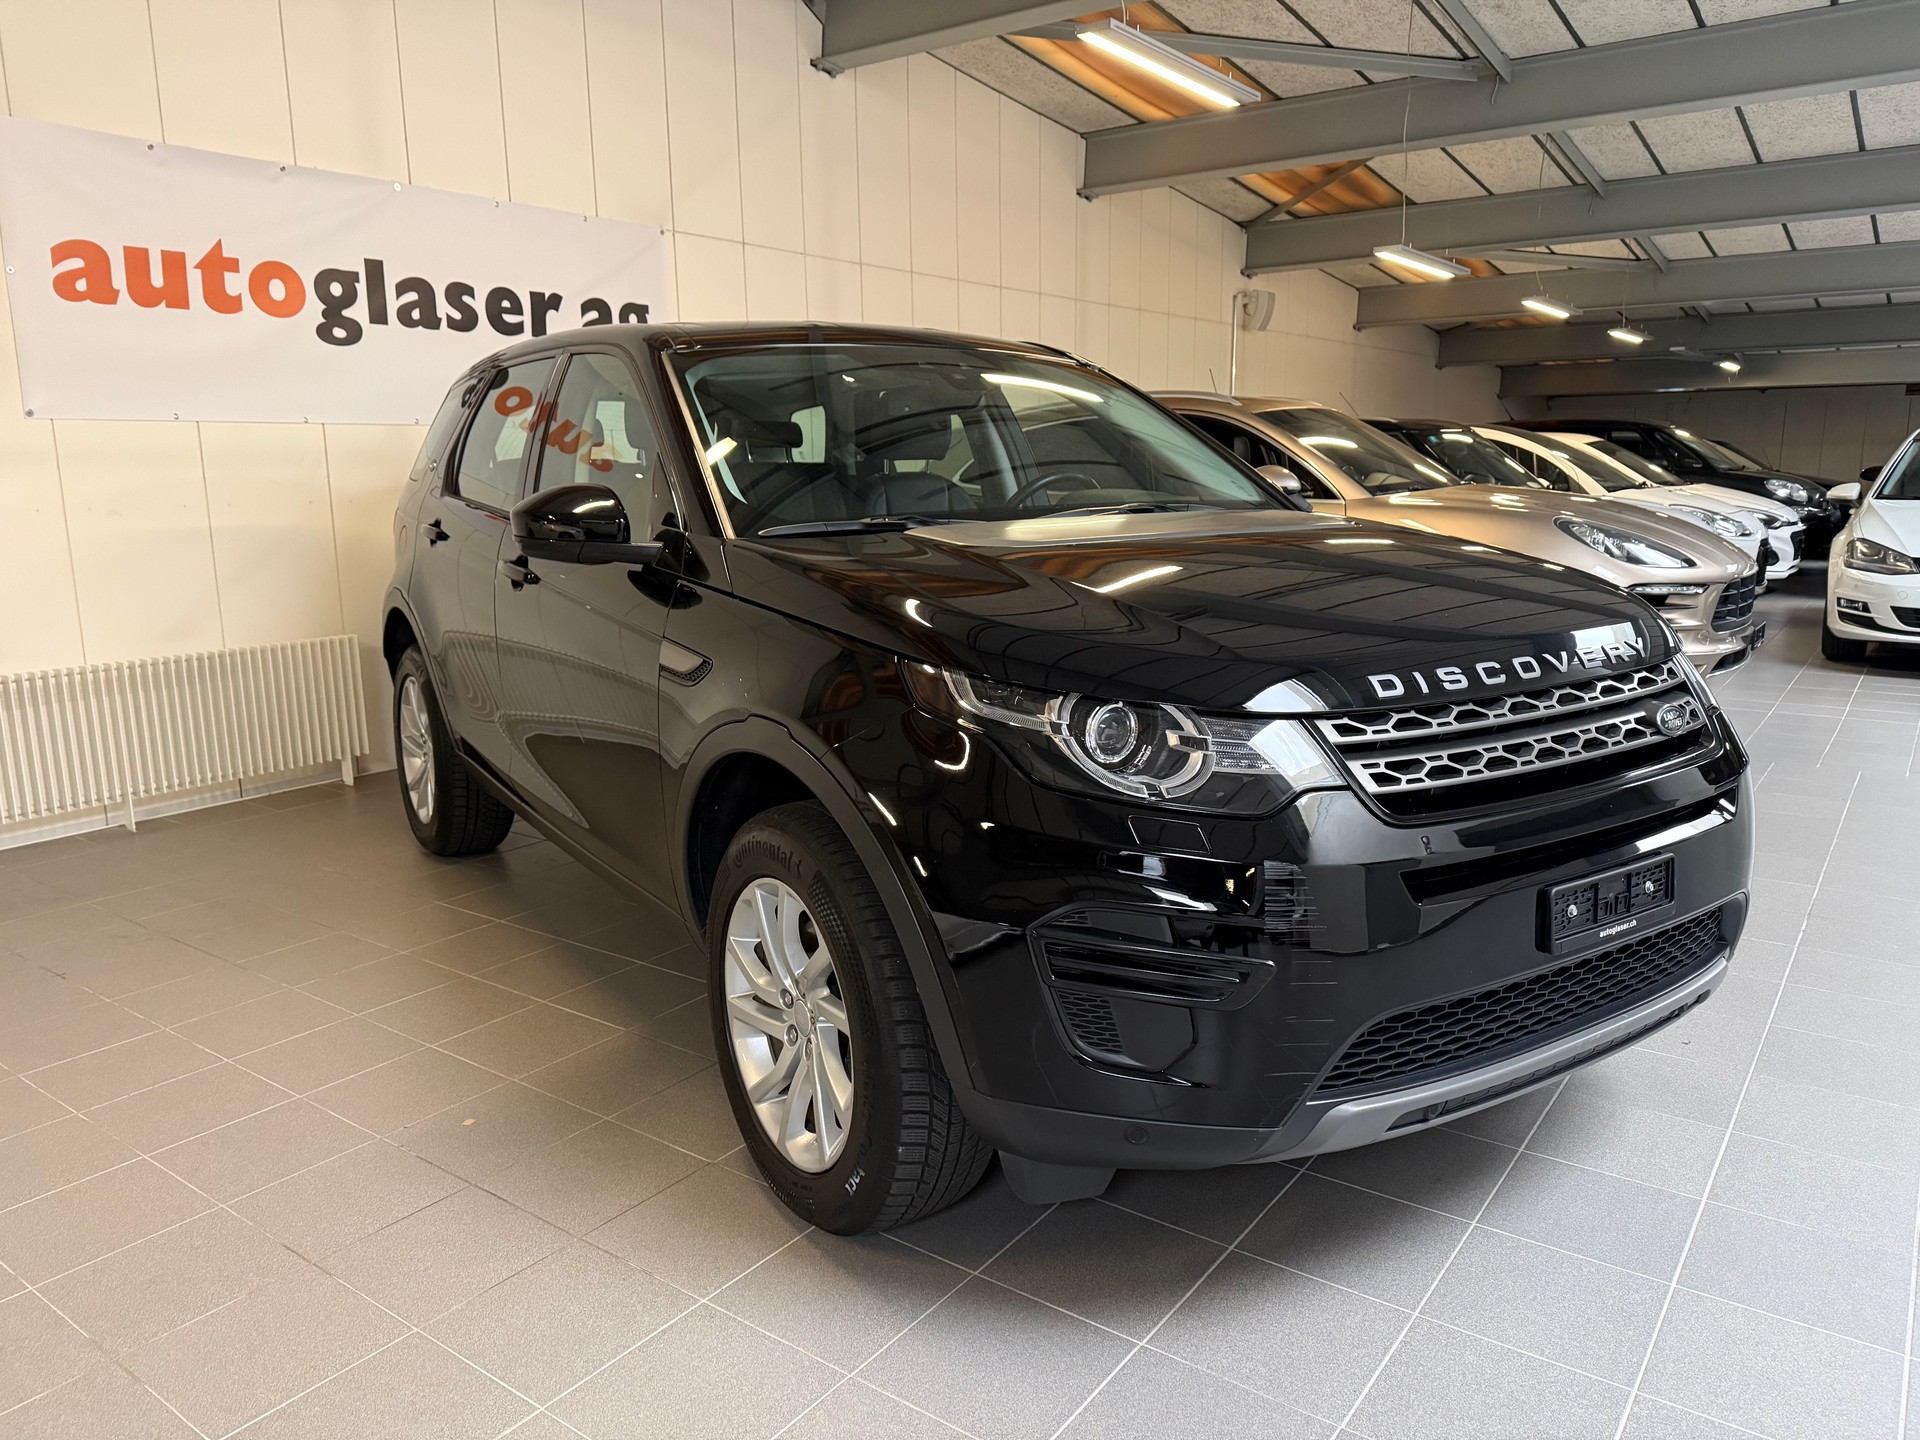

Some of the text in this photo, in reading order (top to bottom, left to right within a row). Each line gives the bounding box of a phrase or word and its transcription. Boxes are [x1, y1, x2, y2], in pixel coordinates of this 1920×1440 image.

[50, 237, 563, 347] autoglaser
[1366, 637, 1647, 700] DISCOVERY
[733, 834, 794, 873] Continental
[1600, 919, 1637, 938] autoglaser.ch
